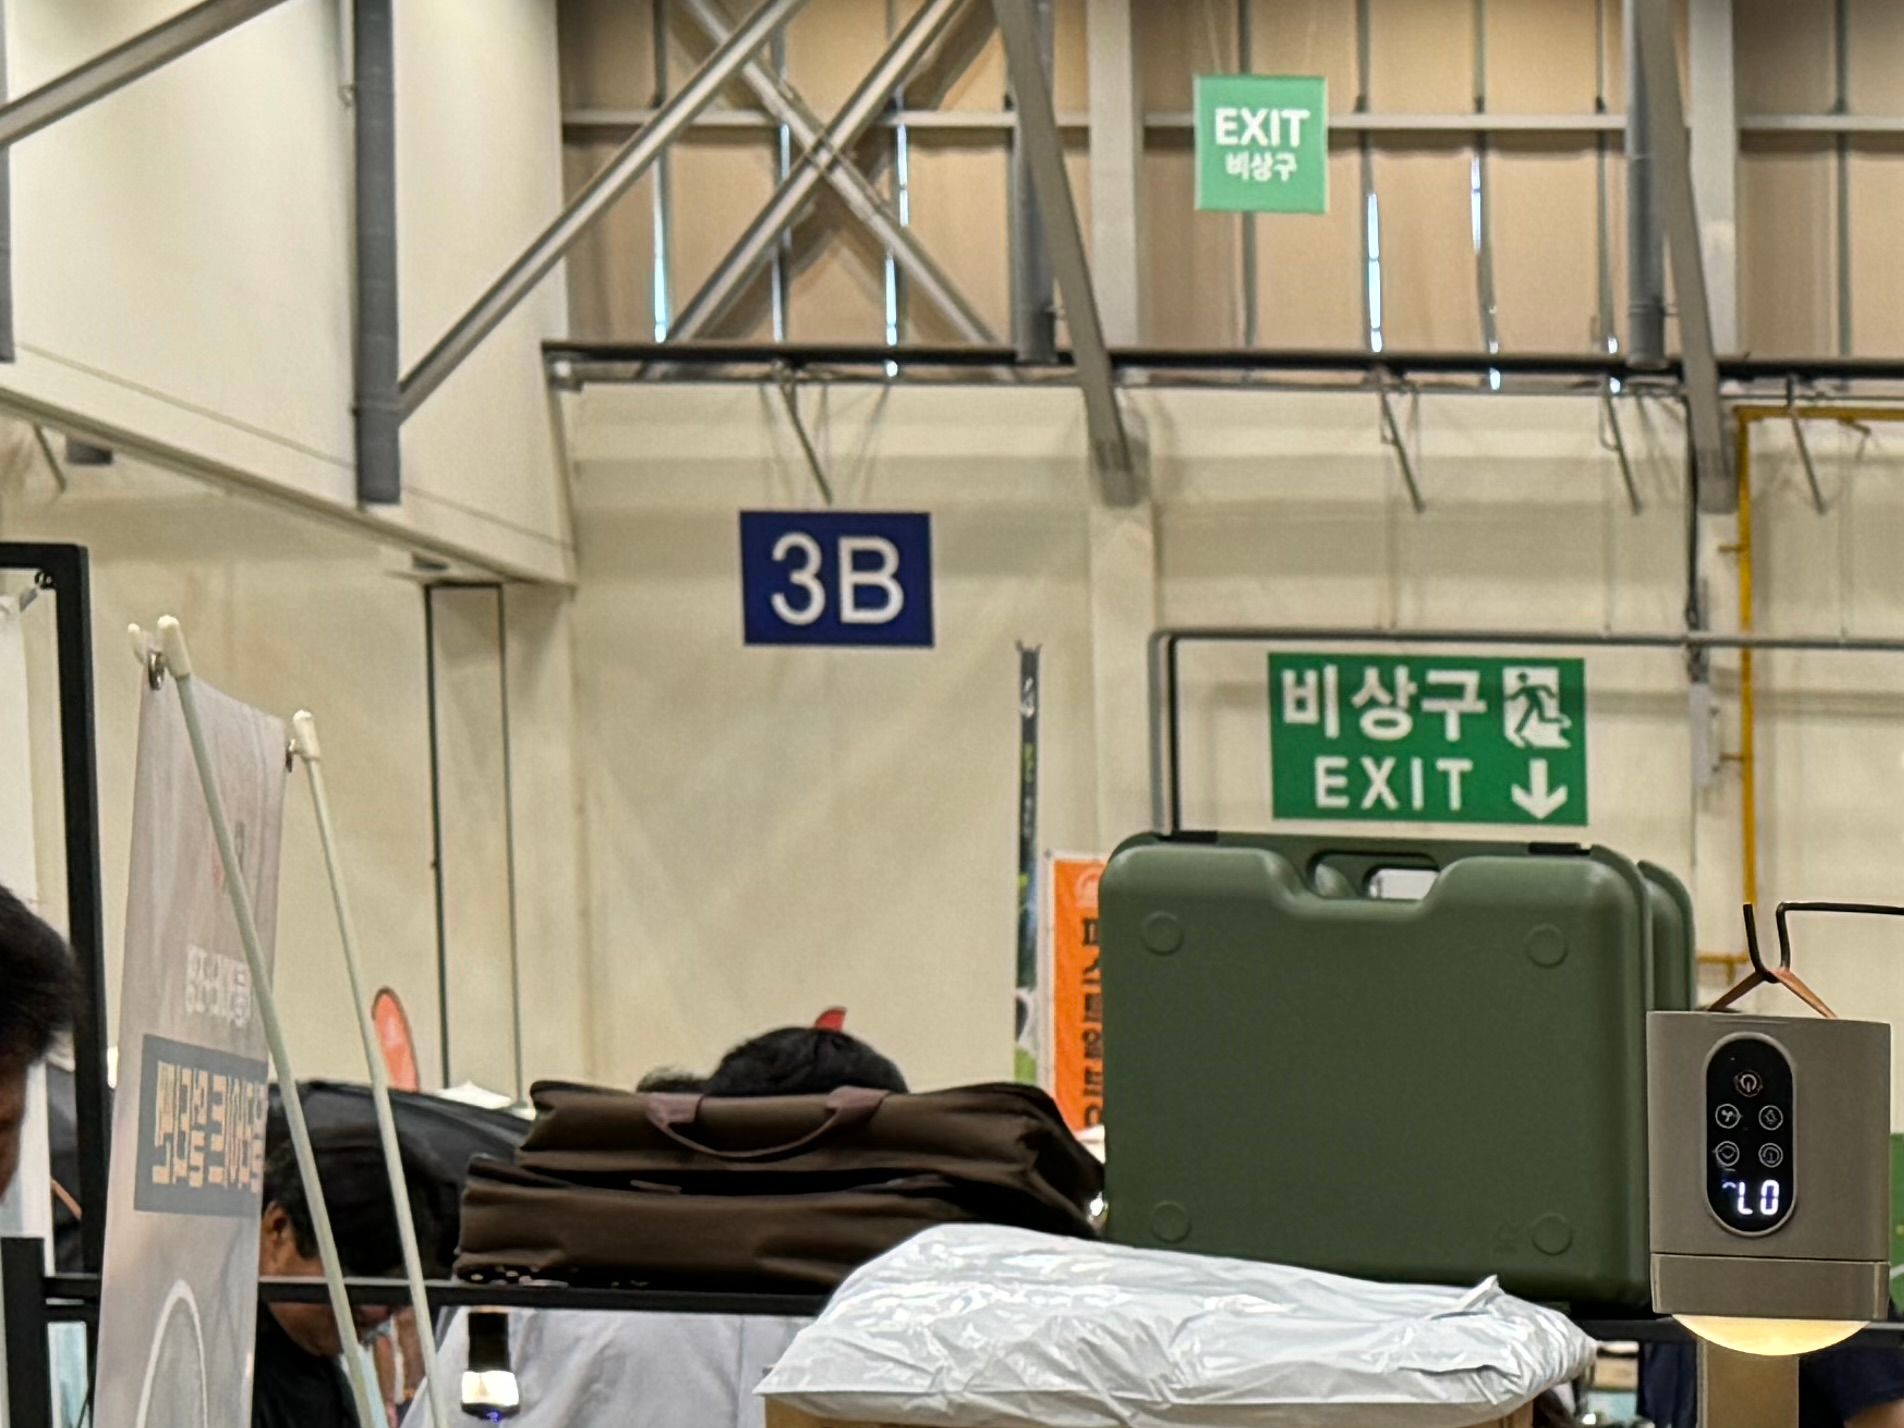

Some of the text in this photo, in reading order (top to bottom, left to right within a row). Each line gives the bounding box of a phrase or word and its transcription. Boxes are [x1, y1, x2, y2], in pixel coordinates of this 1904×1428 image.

[1213, 106, 1309, 148] EXIT
[1226, 152, 1298, 183] 비상구
[770, 530, 906, 626] 3B
[1282, 666, 1487, 743] 비상구
[1315, 756, 1474, 812] EXIT
